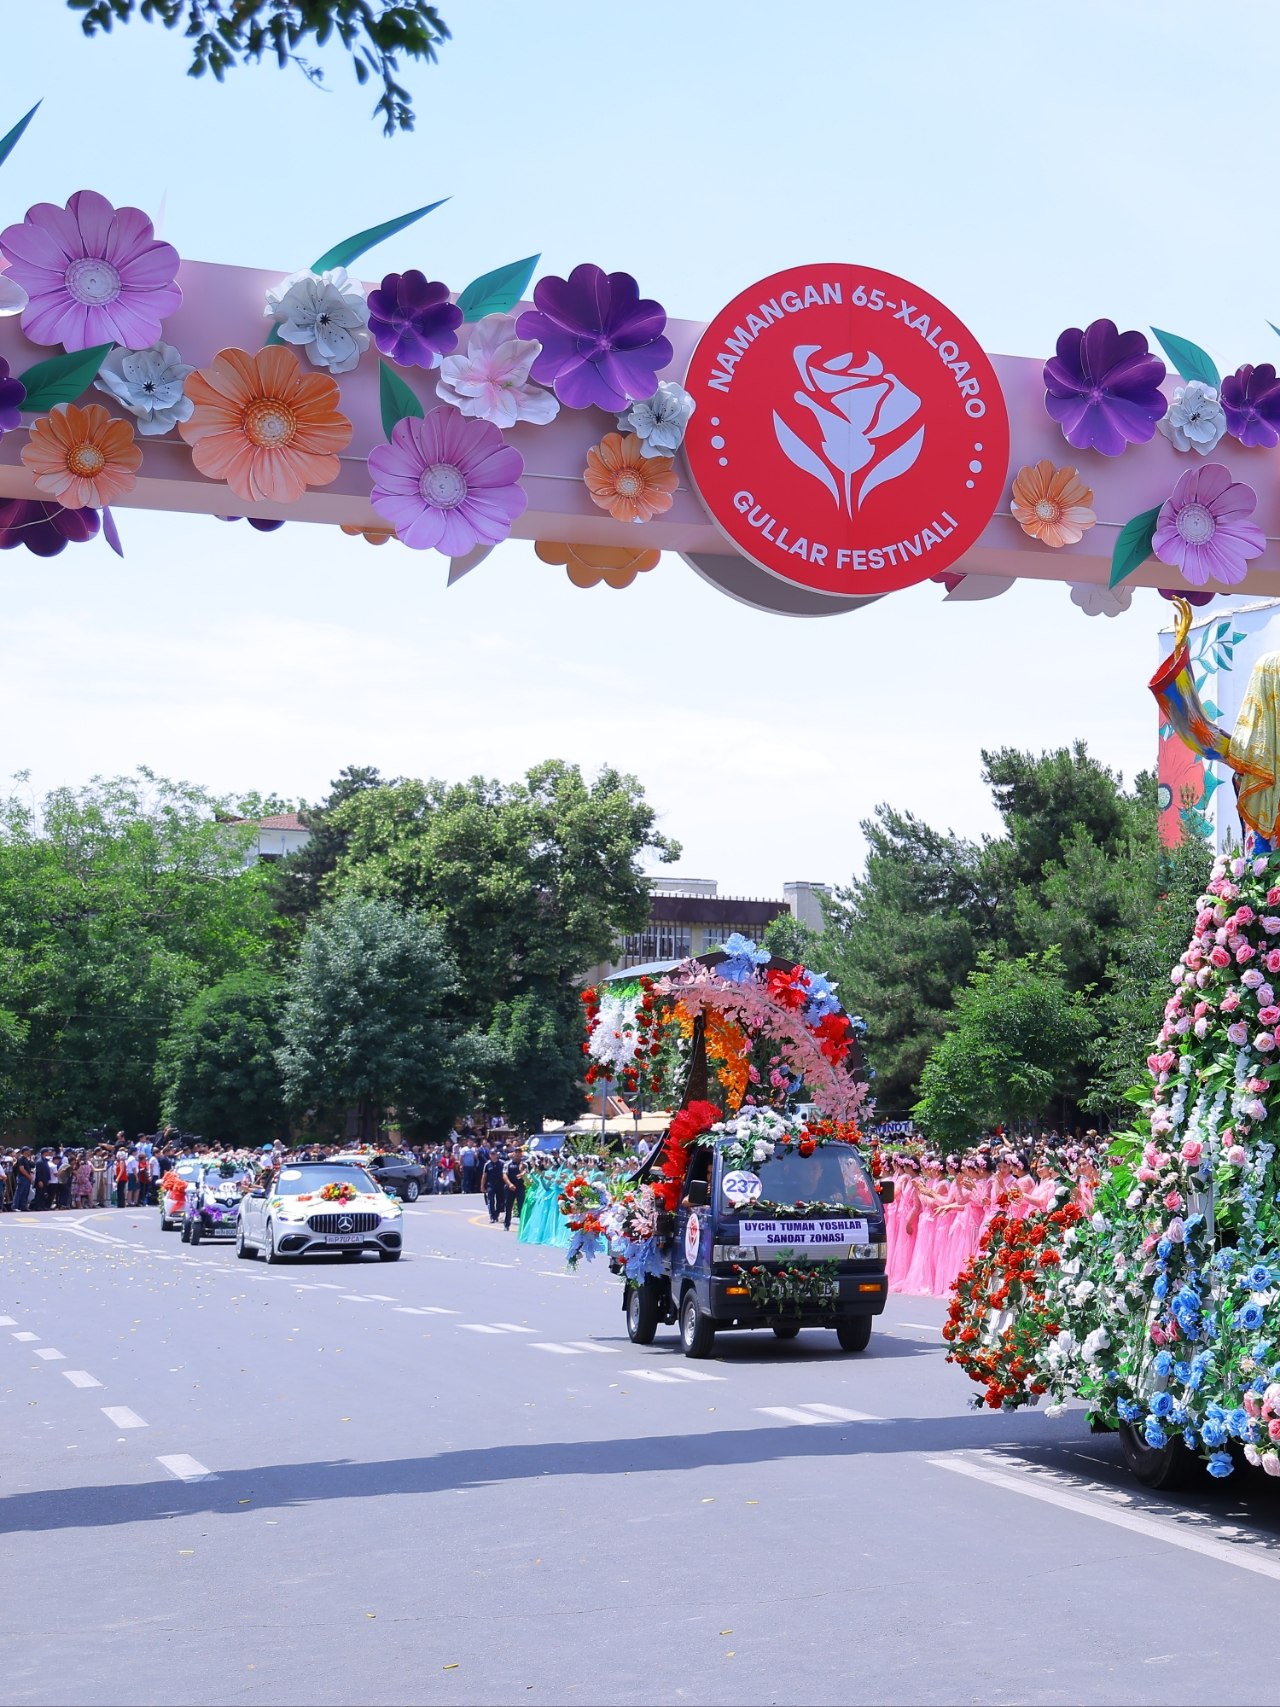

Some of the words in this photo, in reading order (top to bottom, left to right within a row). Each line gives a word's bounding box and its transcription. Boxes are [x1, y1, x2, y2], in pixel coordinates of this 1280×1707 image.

[707, 283, 843, 393] NAMANGAN
[852, 285, 986, 418] 65-XALQARO
[733, 491, 828, 566] GULLAR
[836, 511, 959, 571] FESTIVALI
[726, 1179, 760, 1193] 237
[744, 1222, 776, 1231] UYCHI
[780, 1222, 815, 1231] TUMAN
[819, 1221, 862, 1230] YOSHLAR
[767, 1234, 806, 1243] SANOAT
[810, 1233, 845, 1242] ZONASI
